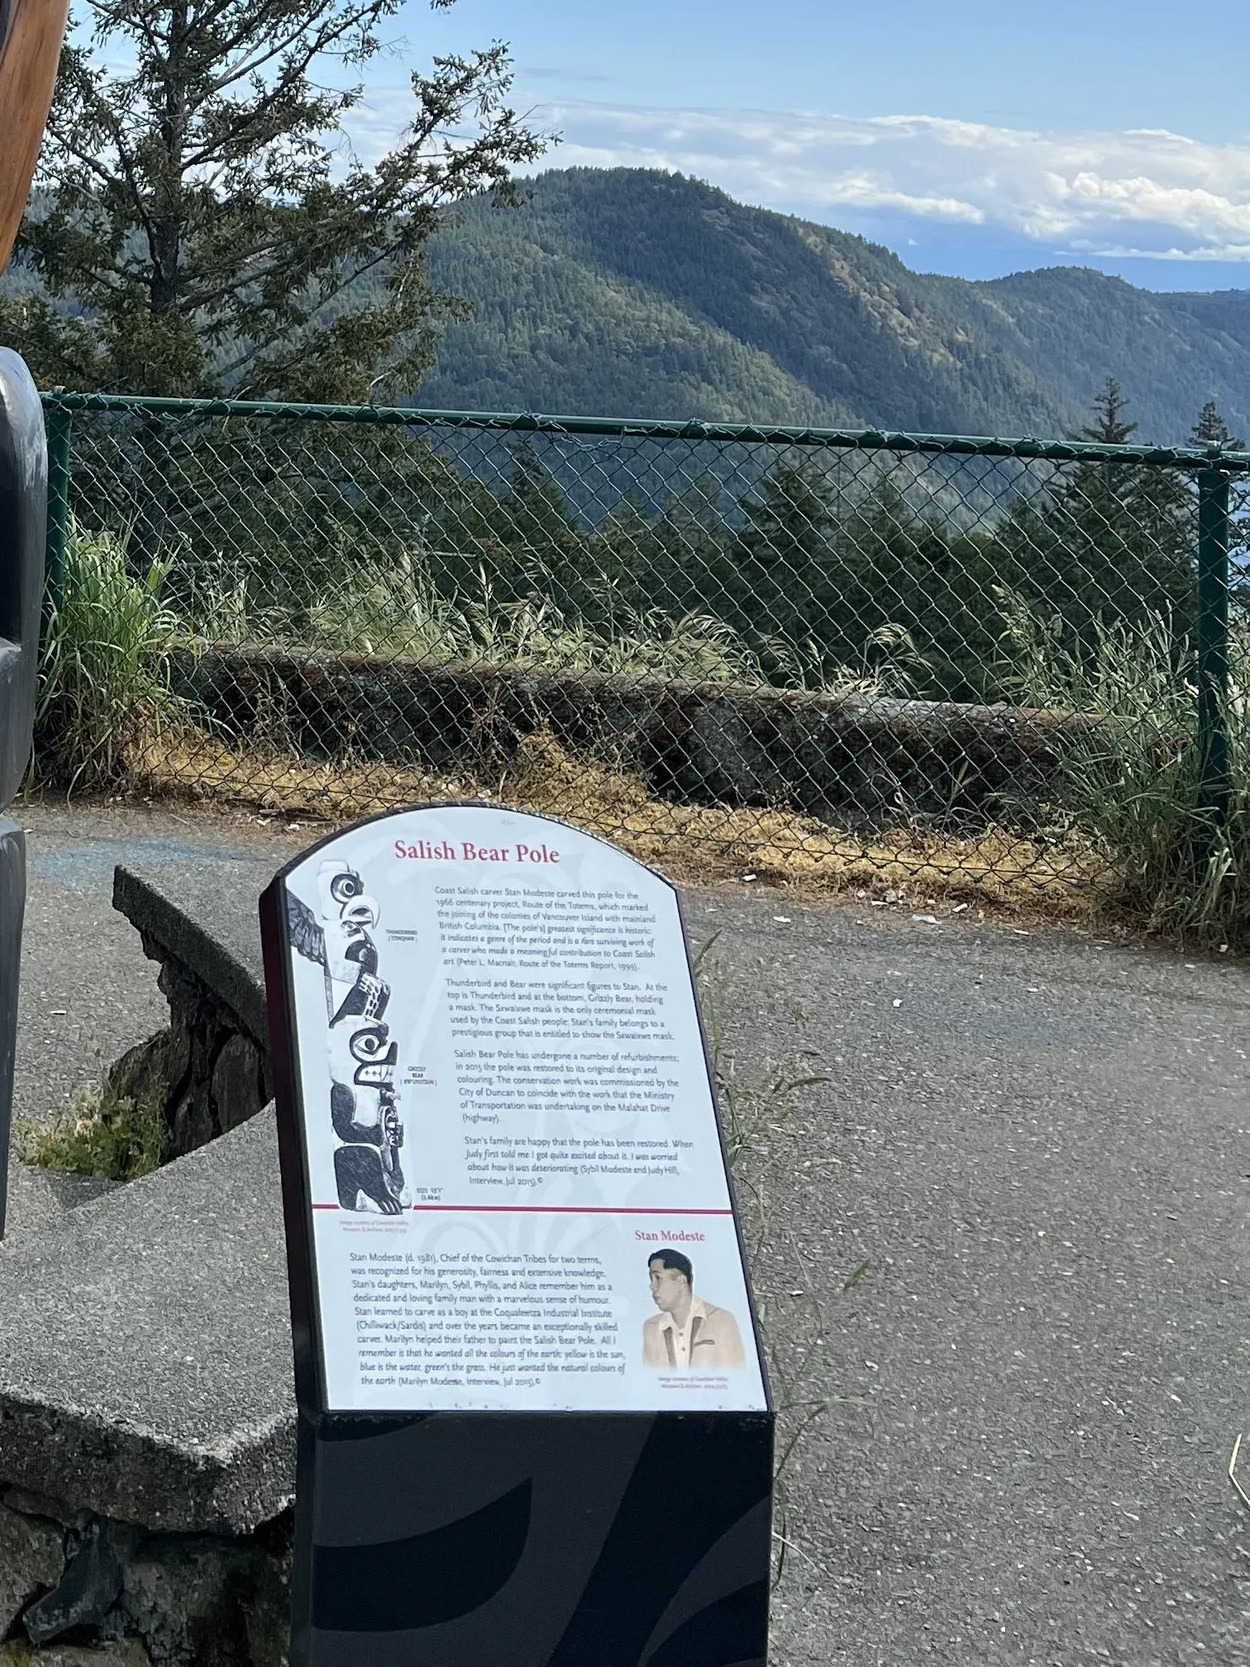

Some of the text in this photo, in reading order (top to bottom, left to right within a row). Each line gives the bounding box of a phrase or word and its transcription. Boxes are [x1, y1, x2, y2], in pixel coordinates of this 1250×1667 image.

[394, 839, 560, 863] Salish Bear Pole
[434, 885, 455, 894] Coast
[457, 885, 478, 894] Salish
[504, 887, 521, 896] Stan
[523, 887, 555, 896] Modeste
[556, 888, 580, 897] carved
[582, 889, 595, 898] this
[597, 889, 613, 901] pole
[614, 890, 624, 899] for
[626, 890, 638, 899] the
[437, 908, 449, 917] the
[478, 909, 485, 918] of
[487, 909, 499, 918] the
[532, 911, 540, 919] of
[541, 911, 579, 920] Vancouver
[605, 913, 620, 922] with
[446, 977, 491, 987] Thunderbird
[493, 978, 507, 987] and
[509, 978, 525, 987] Bear
[547, 979, 584, 992] significant
[586, 980, 611, 992] figures
[613, 982, 621, 990] to
[645, 982, 653, 991] At
[655, 982, 667, 991] the
[447, 990, 459, 1001] top
[470, 990, 516, 999] Thunderbird
[518, 991, 532, 1000] and
[533, 992, 541, 1000] at
[542, 991, 554, 1000] the
[635, 993, 663, 1005] holding
[454, 1048, 476, 1057] Salish
[478, 1048, 495, 1058] Bear
[497, 1049, 514, 1058] Pole
[515, 1049, 528, 1058] has
[531, 1049, 572, 1062] undergone
[580, 1050, 609, 1060] number
[610, 1051, 619, 1060] of
[496, 1074, 511, 1083] The
[513, 1074, 560, 1084] conservation
[563, 1075, 581, 1084] work
[600, 1076, 654, 1086] commissioned
[656, 1077, 665, 1089] by
[666, 1077, 678, 1086] the
[458, 1086, 674, 1102] City of Duncan to coincide with the work that the Ministry
[460, 1098, 468, 1108] of
[470, 1099, 525, 1112] Transportation
[544, 1100, 590, 1113] undertaking
[603, 1101, 616, 1110] the
[618, 1101, 648, 1111] Malahat
[650, 1102, 670, 1112] Drive
[464, 1134, 487, 1144] Stan's
[489, 1135, 512, 1147] family
[527, 1136, 550, 1148] happy
[552, 1136, 567, 1145] that
[568, 1136, 581, 1146] the
[583, 1136, 599, 1149] pole
[601, 1137, 614, 1146] has
[616, 1137, 635, 1146] been
[635, 1229, 705, 1241] Stan Modeste
[350, 1250, 367, 1260] Stan
[369, 1251, 402, 1261] Modeste
[440, 1252, 460, 1261] Chief
[461, 1252, 469, 1262] of
[471, 1252, 483, 1262] the
[485, 1252, 522, 1262] Cowichan
[523, 1253, 546, 1262] Tribes
[548, 1253, 558, 1263] for
[561, 1254, 575, 1263] two
[368, 1265, 409, 1277] recognized
[411, 1265, 422, 1274] for
[423, 1265, 435, 1275] his
[480, 1266, 508, 1275] fairness
[511, 1266, 526, 1276] and
[527, 1266, 562, 1276] extensive
[351, 1278, 375, 1287] Stan's
[502, 1280, 517, 1289] and
[519, 1280, 537, 1289] Alice
[539, 1280, 578, 1290] remember
[580, 1280, 595, 1290] him
[353, 1292, 391, 1301] dedicated
[393, 1292, 407, 1301] and
[409, 1292, 432, 1304] loving
[434, 1292, 457, 1304] family
[478, 1293, 495, 1302] with
[503, 1293, 543, 1302] marvelous
[569, 1294, 577, 1303] of
